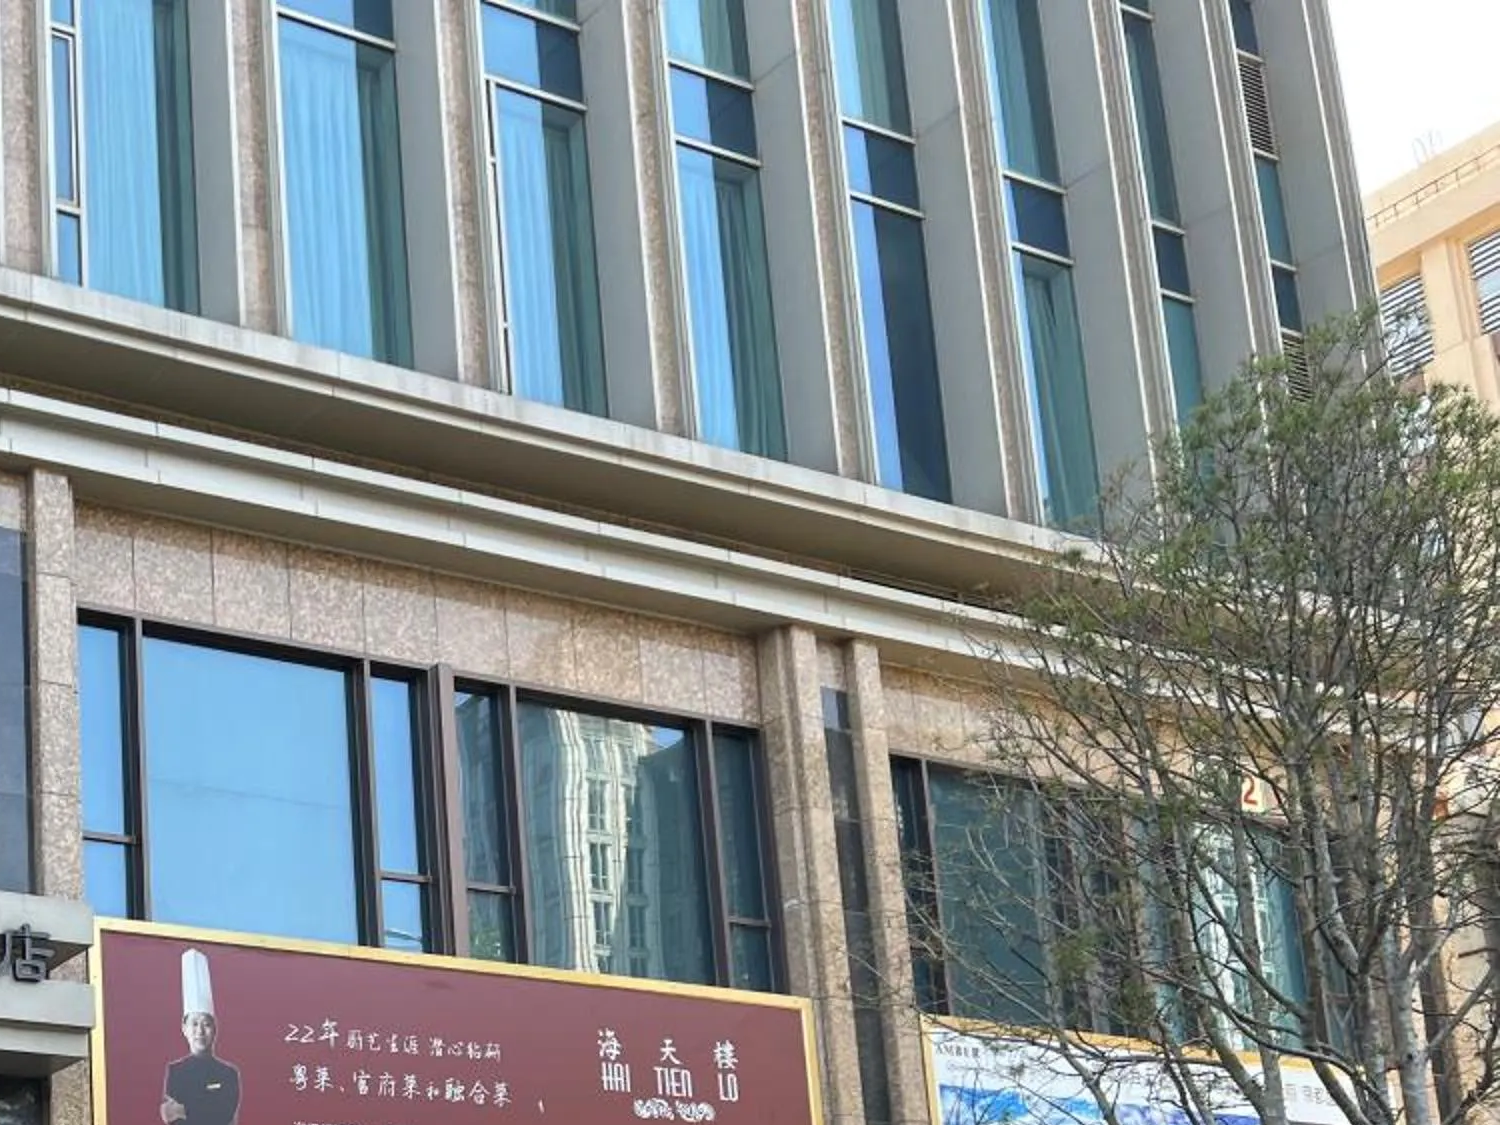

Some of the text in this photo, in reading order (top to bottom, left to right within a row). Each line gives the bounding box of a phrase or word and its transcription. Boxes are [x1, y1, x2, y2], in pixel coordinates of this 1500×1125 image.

[601, 1062, 740, 1103] HAI TIEN LO
